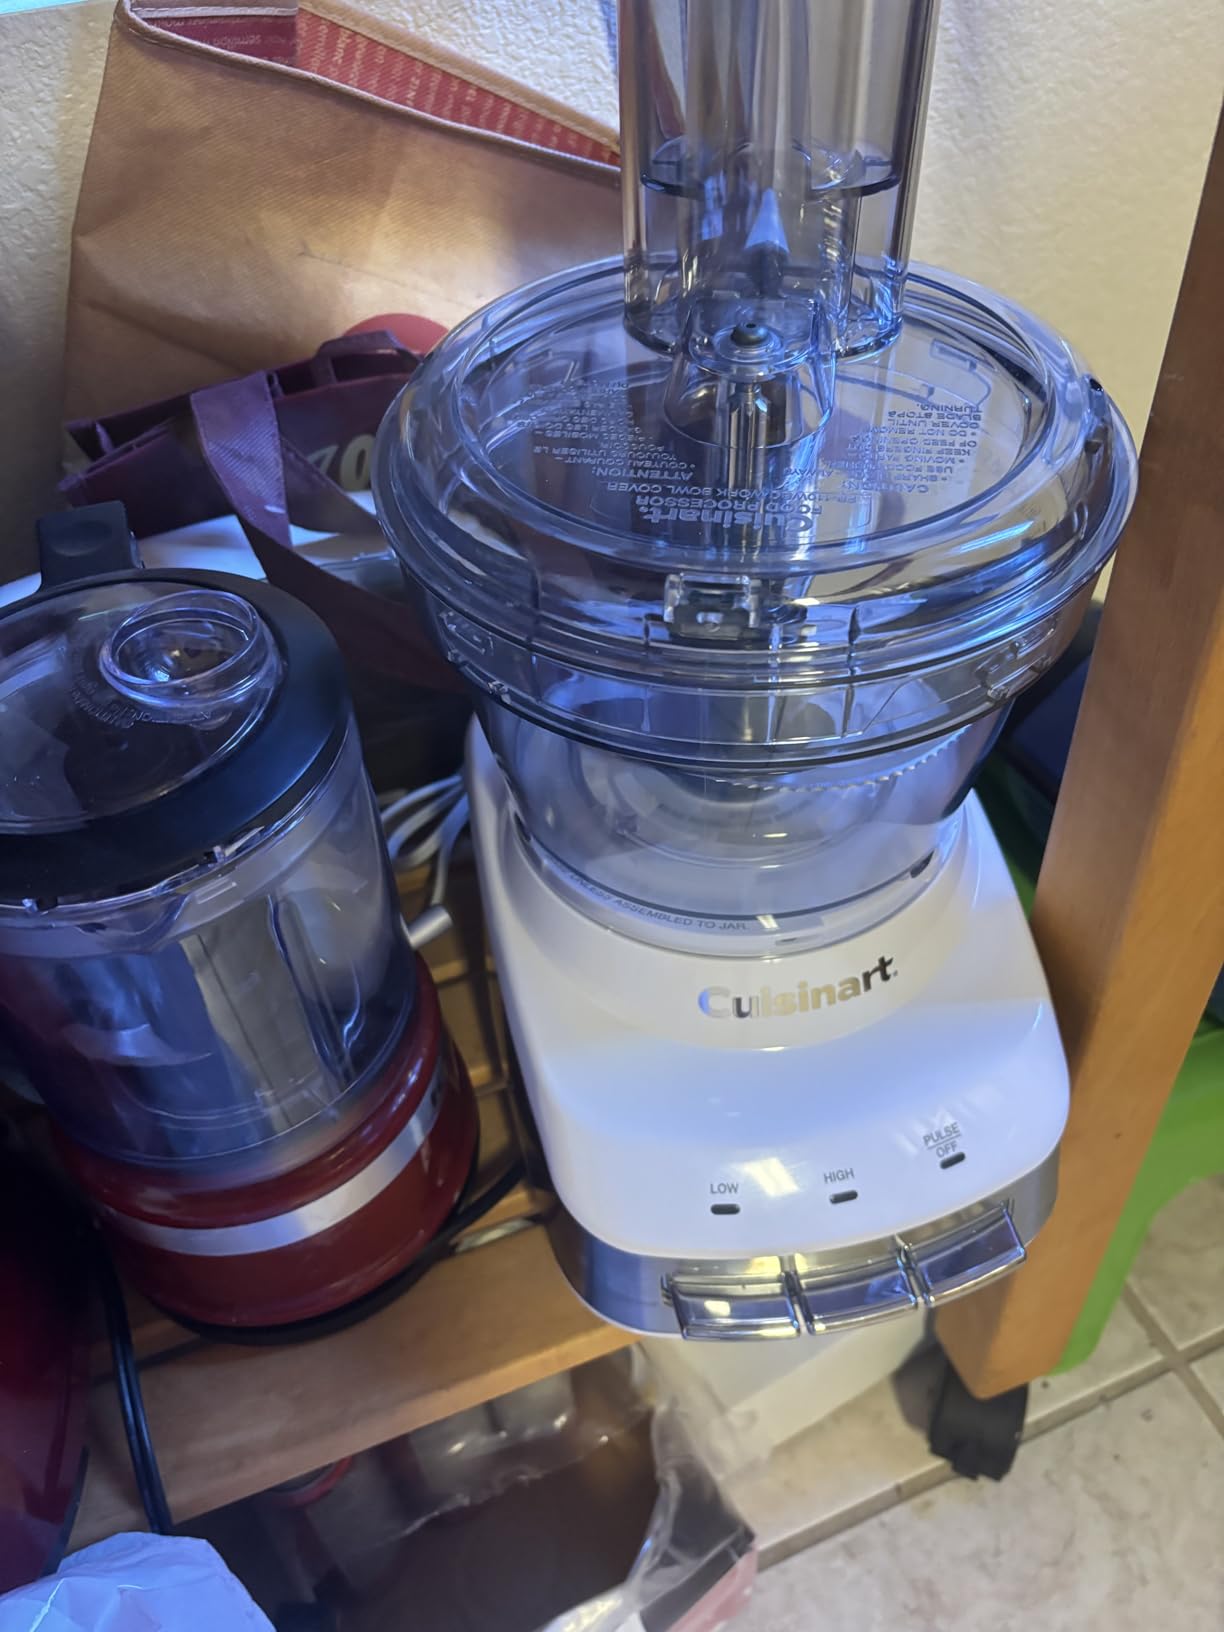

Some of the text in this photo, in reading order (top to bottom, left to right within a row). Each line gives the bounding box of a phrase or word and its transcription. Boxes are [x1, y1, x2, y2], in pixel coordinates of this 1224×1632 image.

[888, 419, 979, 429] COVER UNTIL
[937, 413, 981, 422] BLADE
[959, 440, 977, 448] OF
[592, 466, 693, 481] ATTENTION:
[608, 482, 662, 494] COVER
[667, 485, 712, 496] BOWL
[636, 496, 822, 515] FOOD PROCESSOR
[615, 899, 693, 926] ASSEMBLED
[697, 920, 717, 929] TO
[923, 1121, 960, 1147] PULSE
[935, 1141, 959, 1159] OFF
[823, 1168, 855, 1185] HIGH
[710, 1183, 739, 1195] LOW
